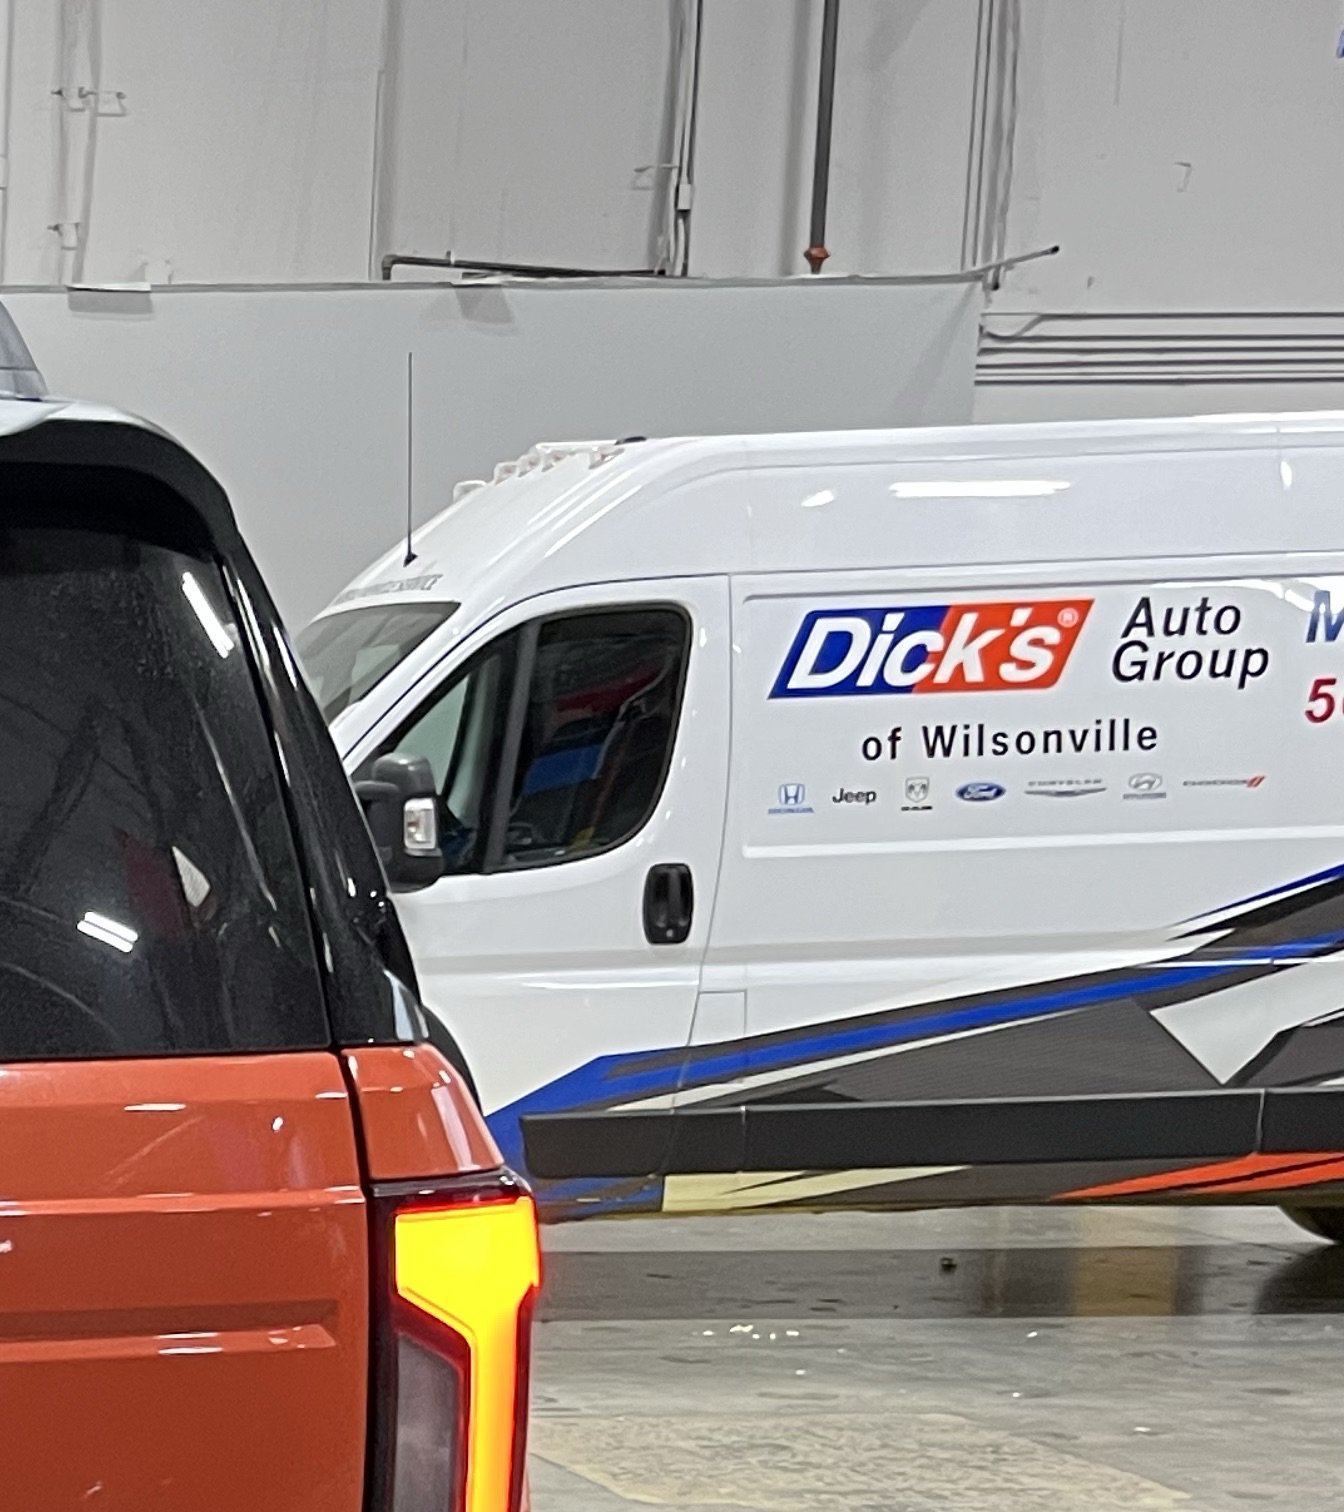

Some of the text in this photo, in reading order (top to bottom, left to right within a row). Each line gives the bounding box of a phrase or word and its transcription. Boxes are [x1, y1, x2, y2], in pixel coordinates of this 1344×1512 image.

[786, 596, 1242, 690] Dick's Auto
[1113, 640, 1270, 690] Group
[1305, 678, 1344, 723] 5
[861, 718, 1158, 761] of Wilsonville
[832, 787, 877, 806] Jeep
